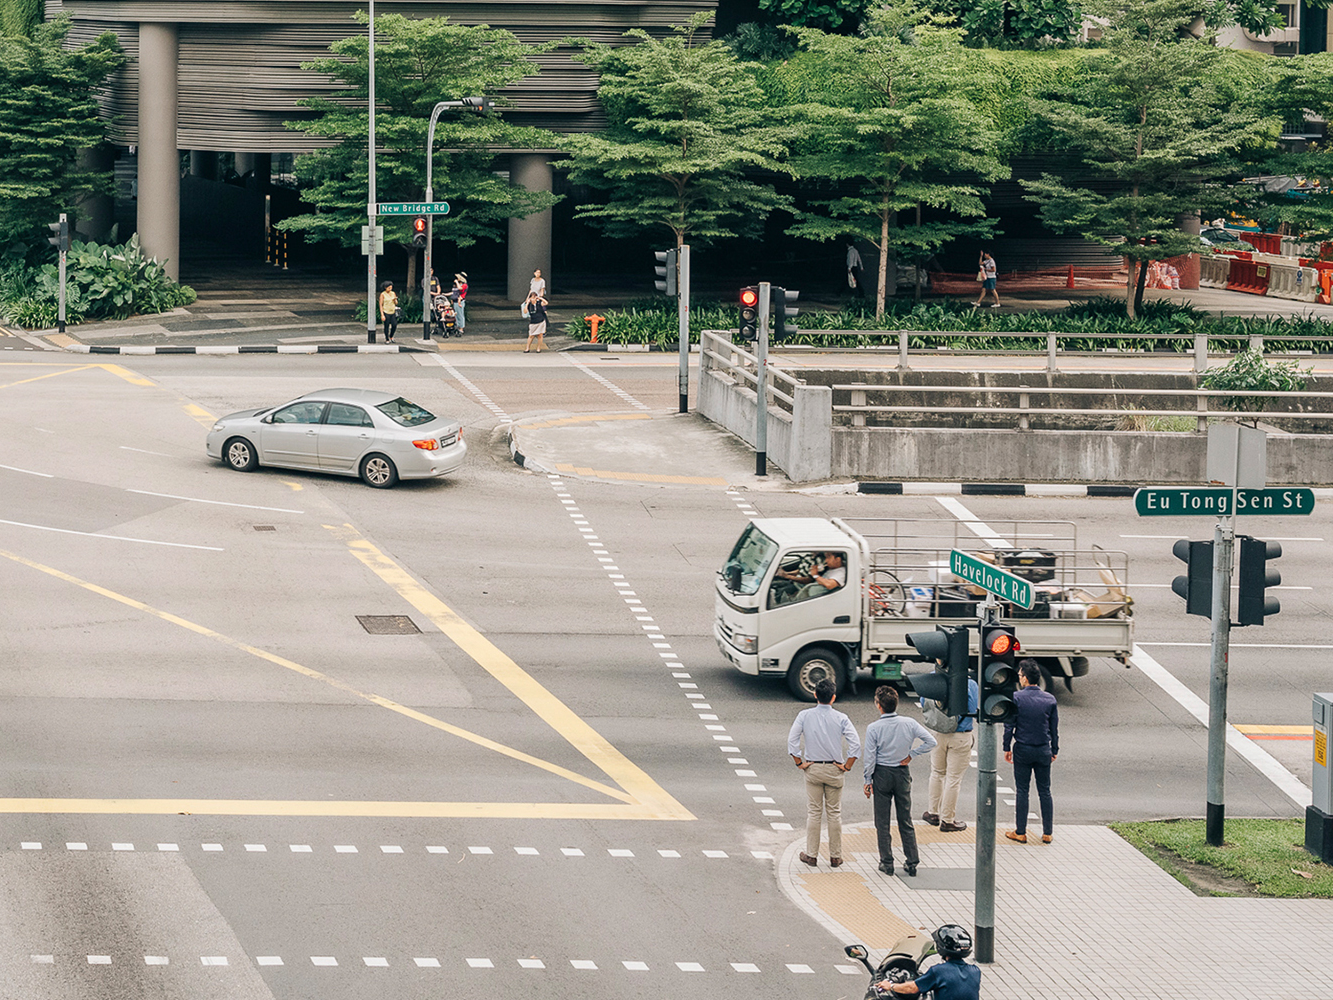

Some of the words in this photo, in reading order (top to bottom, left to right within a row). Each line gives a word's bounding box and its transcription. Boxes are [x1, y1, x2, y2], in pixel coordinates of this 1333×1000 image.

[402, 204, 431, 214] Bridge
[434, 204, 445, 212] Rd
[1147, 492, 1170, 509] Eu
[1180, 492, 1227, 513] Tong
[1237, 491, 1273, 509] Sen
[1282, 491, 1303, 508] St
[954, 554, 1007, 595] Havelock
[1012, 580, 1027, 604] Rd
